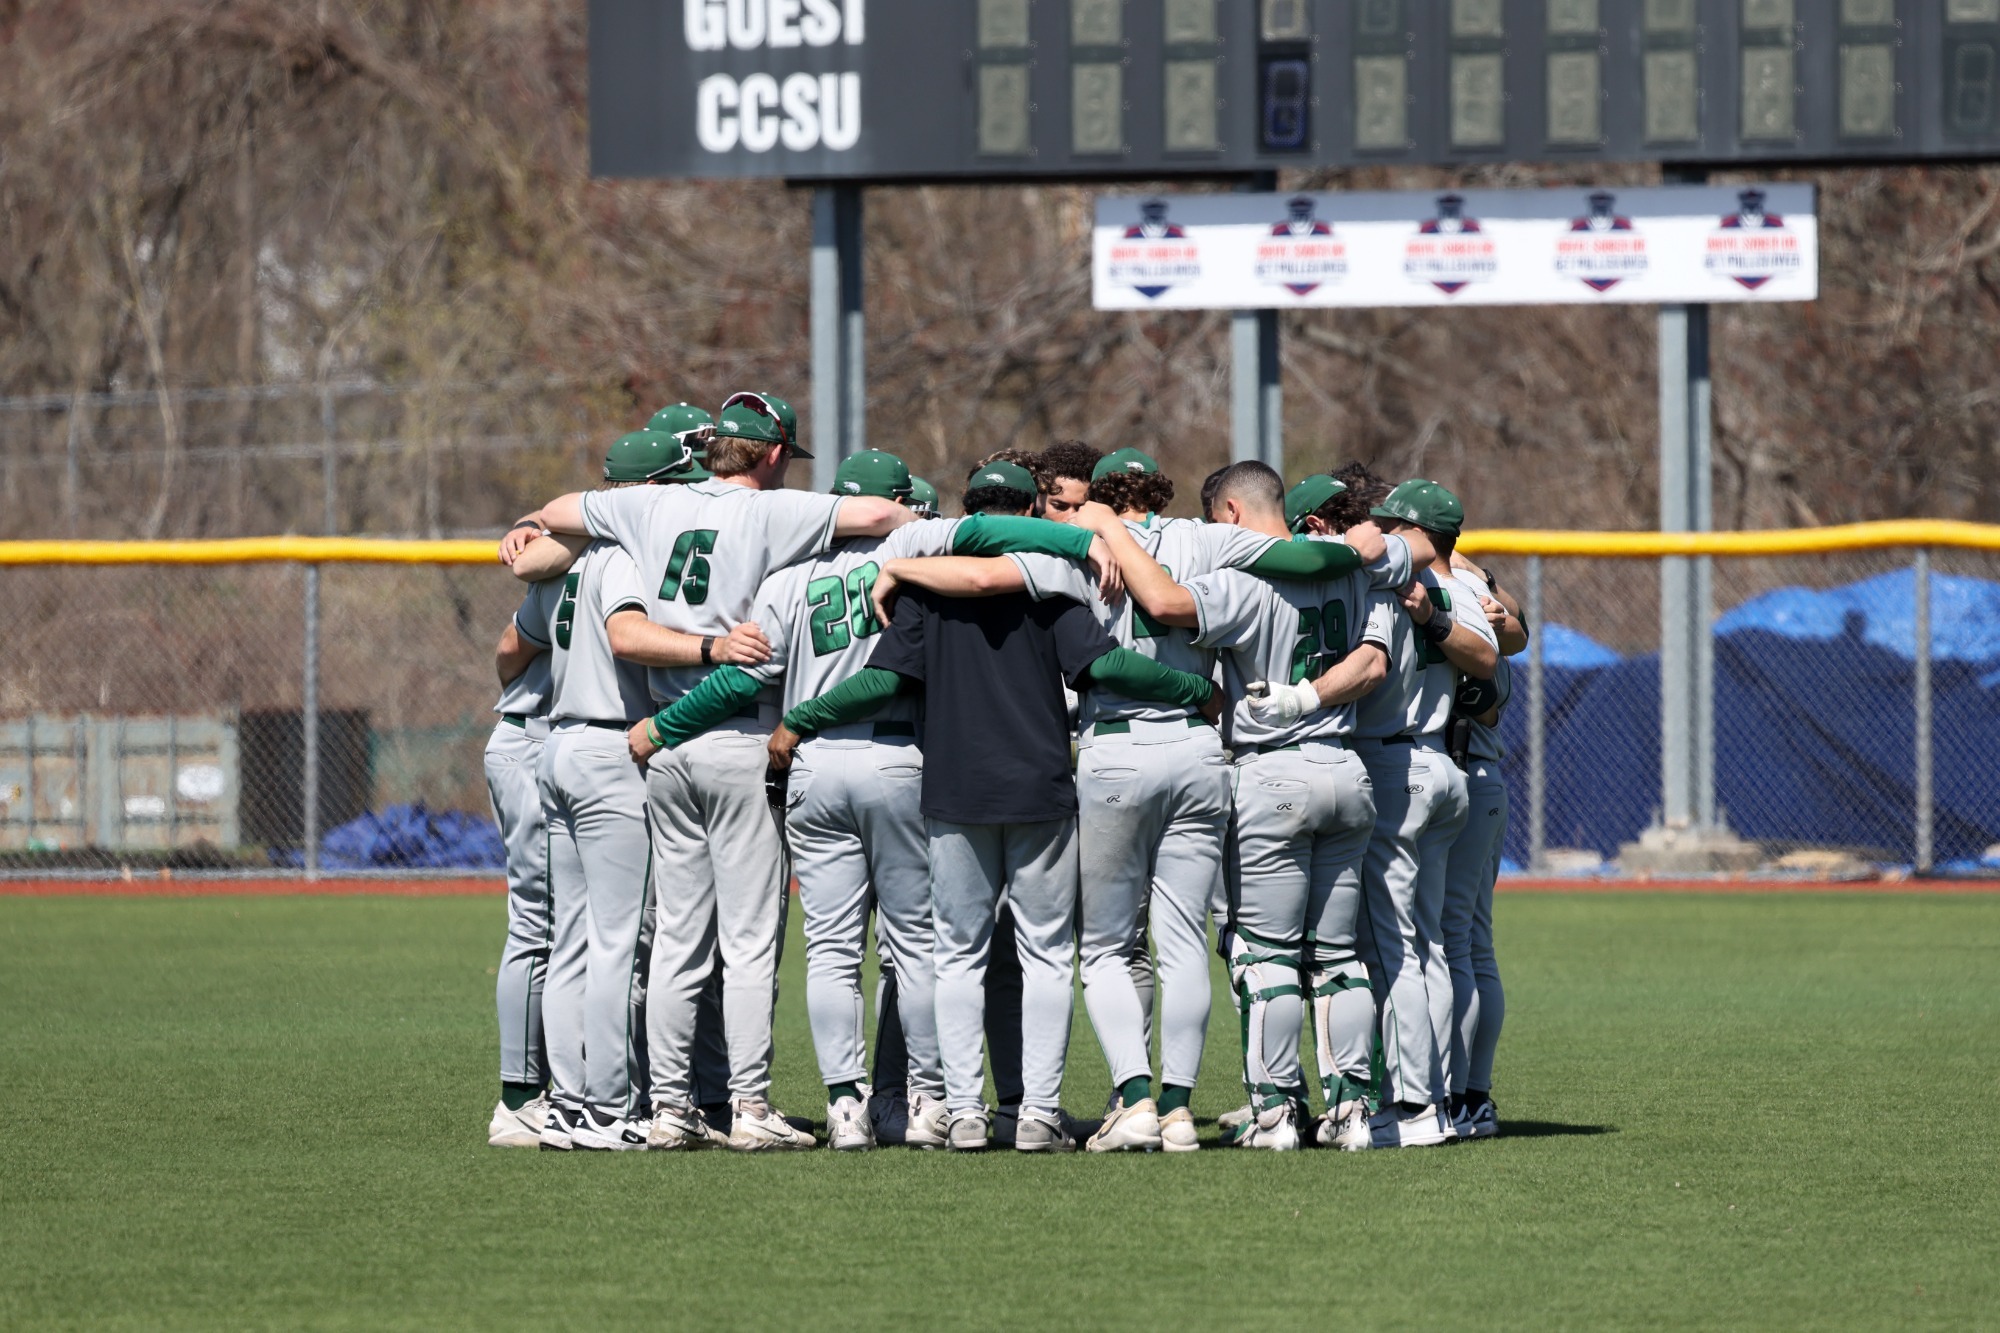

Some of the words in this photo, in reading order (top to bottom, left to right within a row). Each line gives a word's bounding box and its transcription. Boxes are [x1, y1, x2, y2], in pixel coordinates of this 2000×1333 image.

[697, 71, 861, 153] CCSU
[806, 560, 882, 657] 20
[1289, 598, 1348, 685] 29
